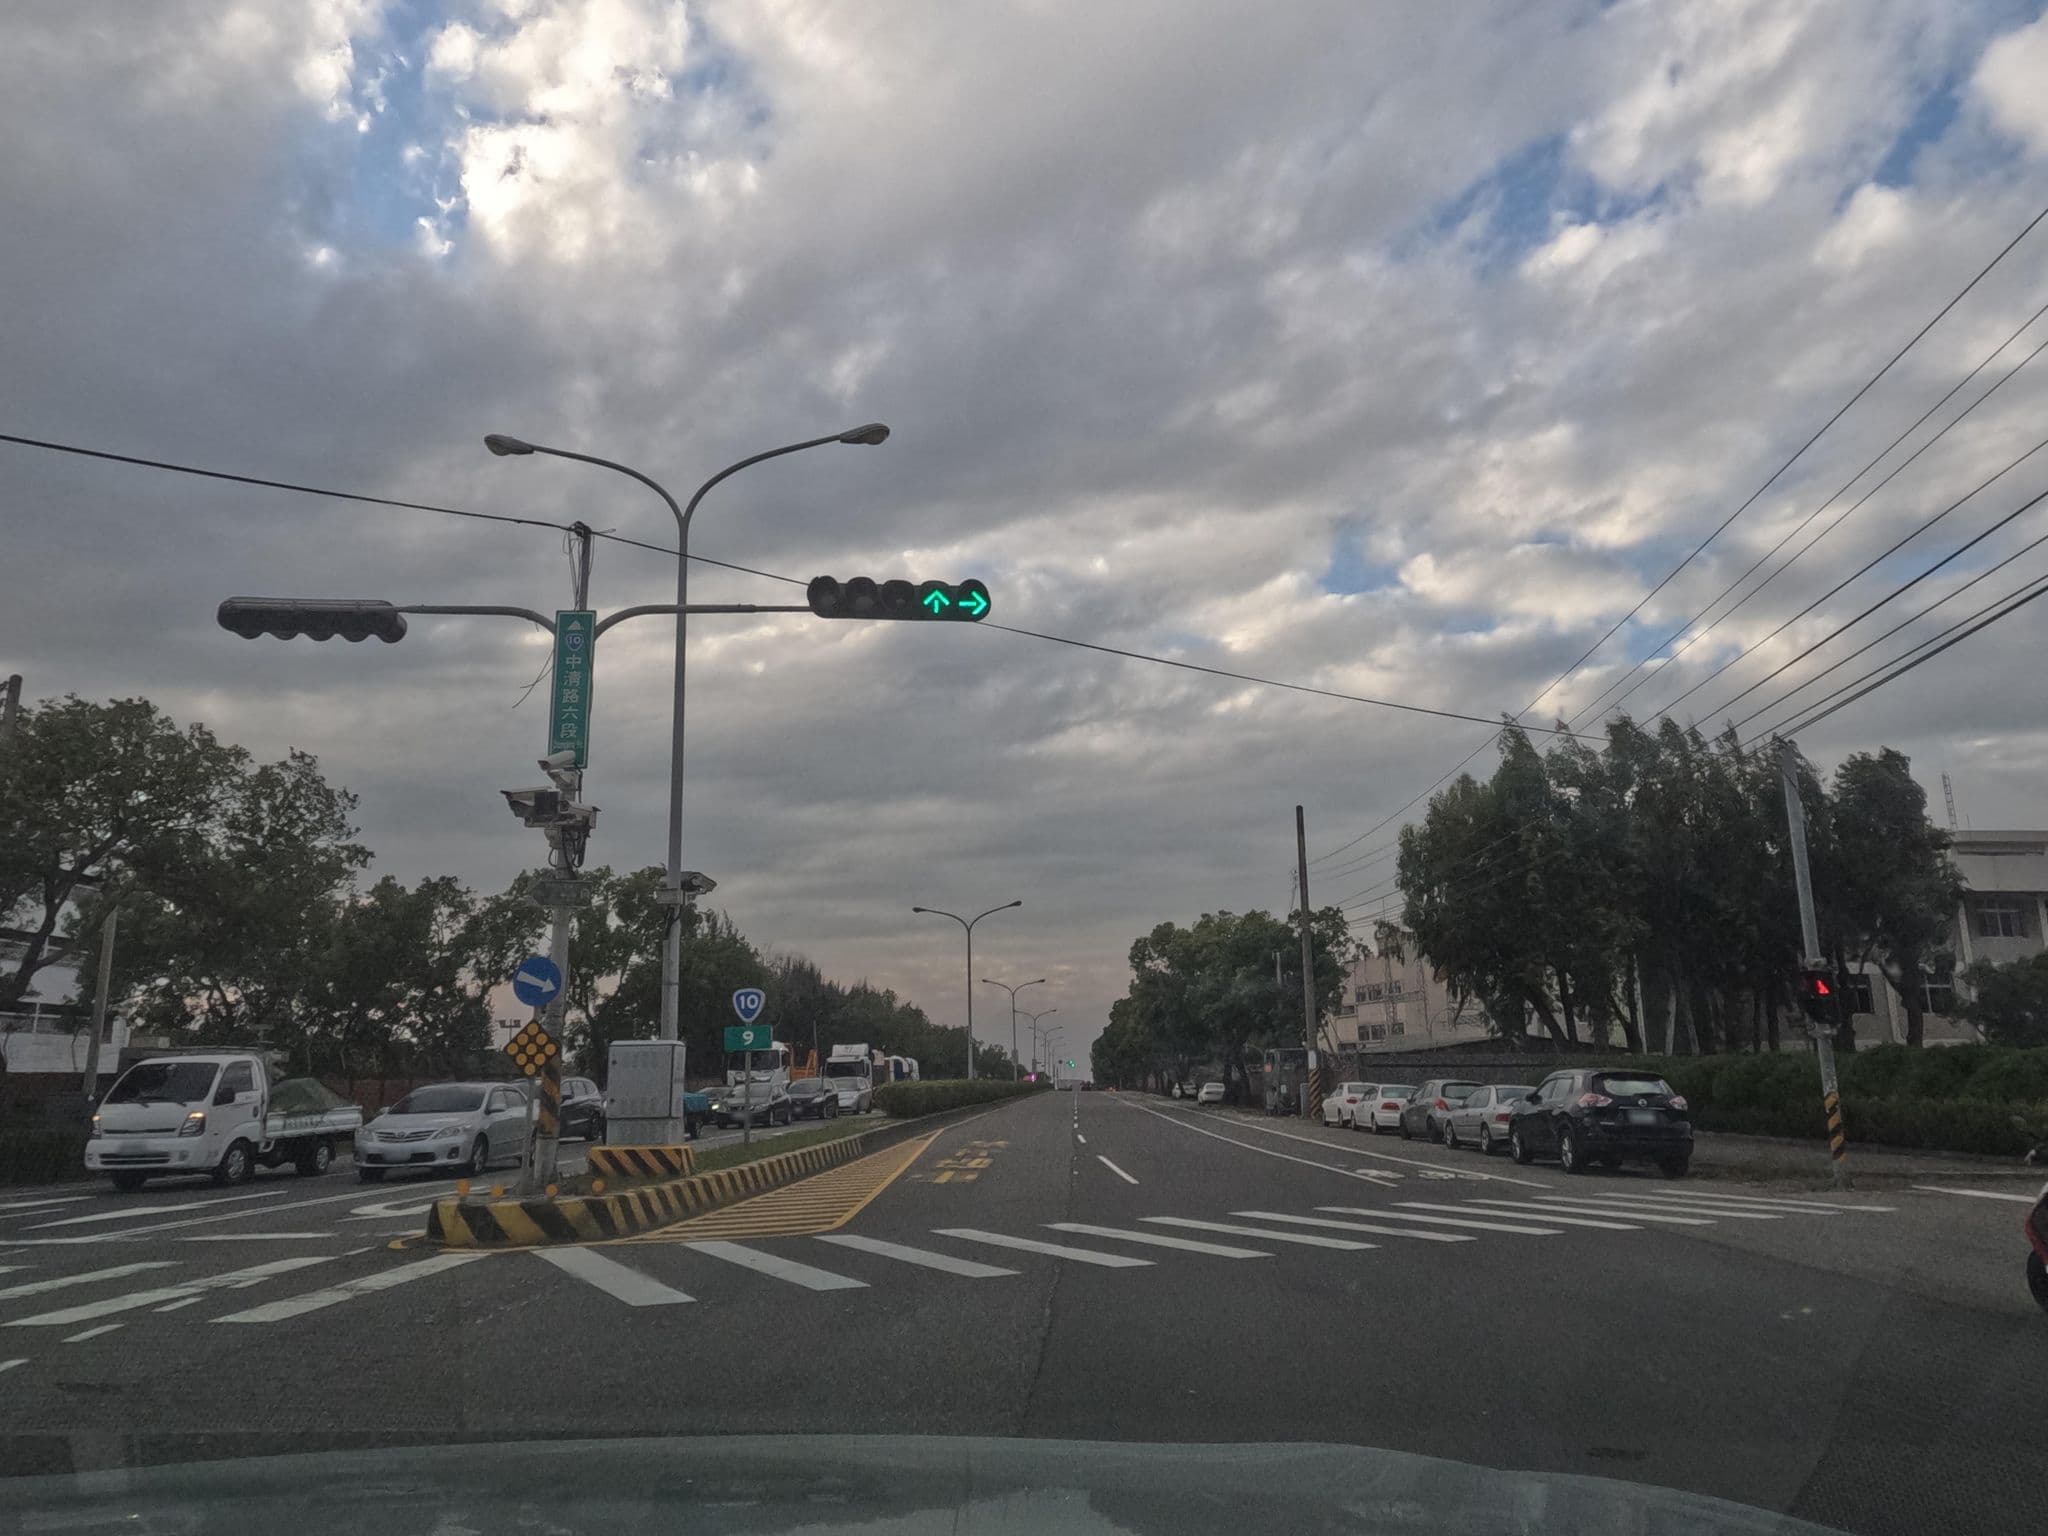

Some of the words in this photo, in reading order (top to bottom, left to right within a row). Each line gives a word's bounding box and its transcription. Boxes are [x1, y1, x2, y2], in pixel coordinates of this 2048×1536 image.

[568, 636, 582, 645] 10
[739, 994, 759, 1010] 10
[742, 1030, 755, 1046] 9
